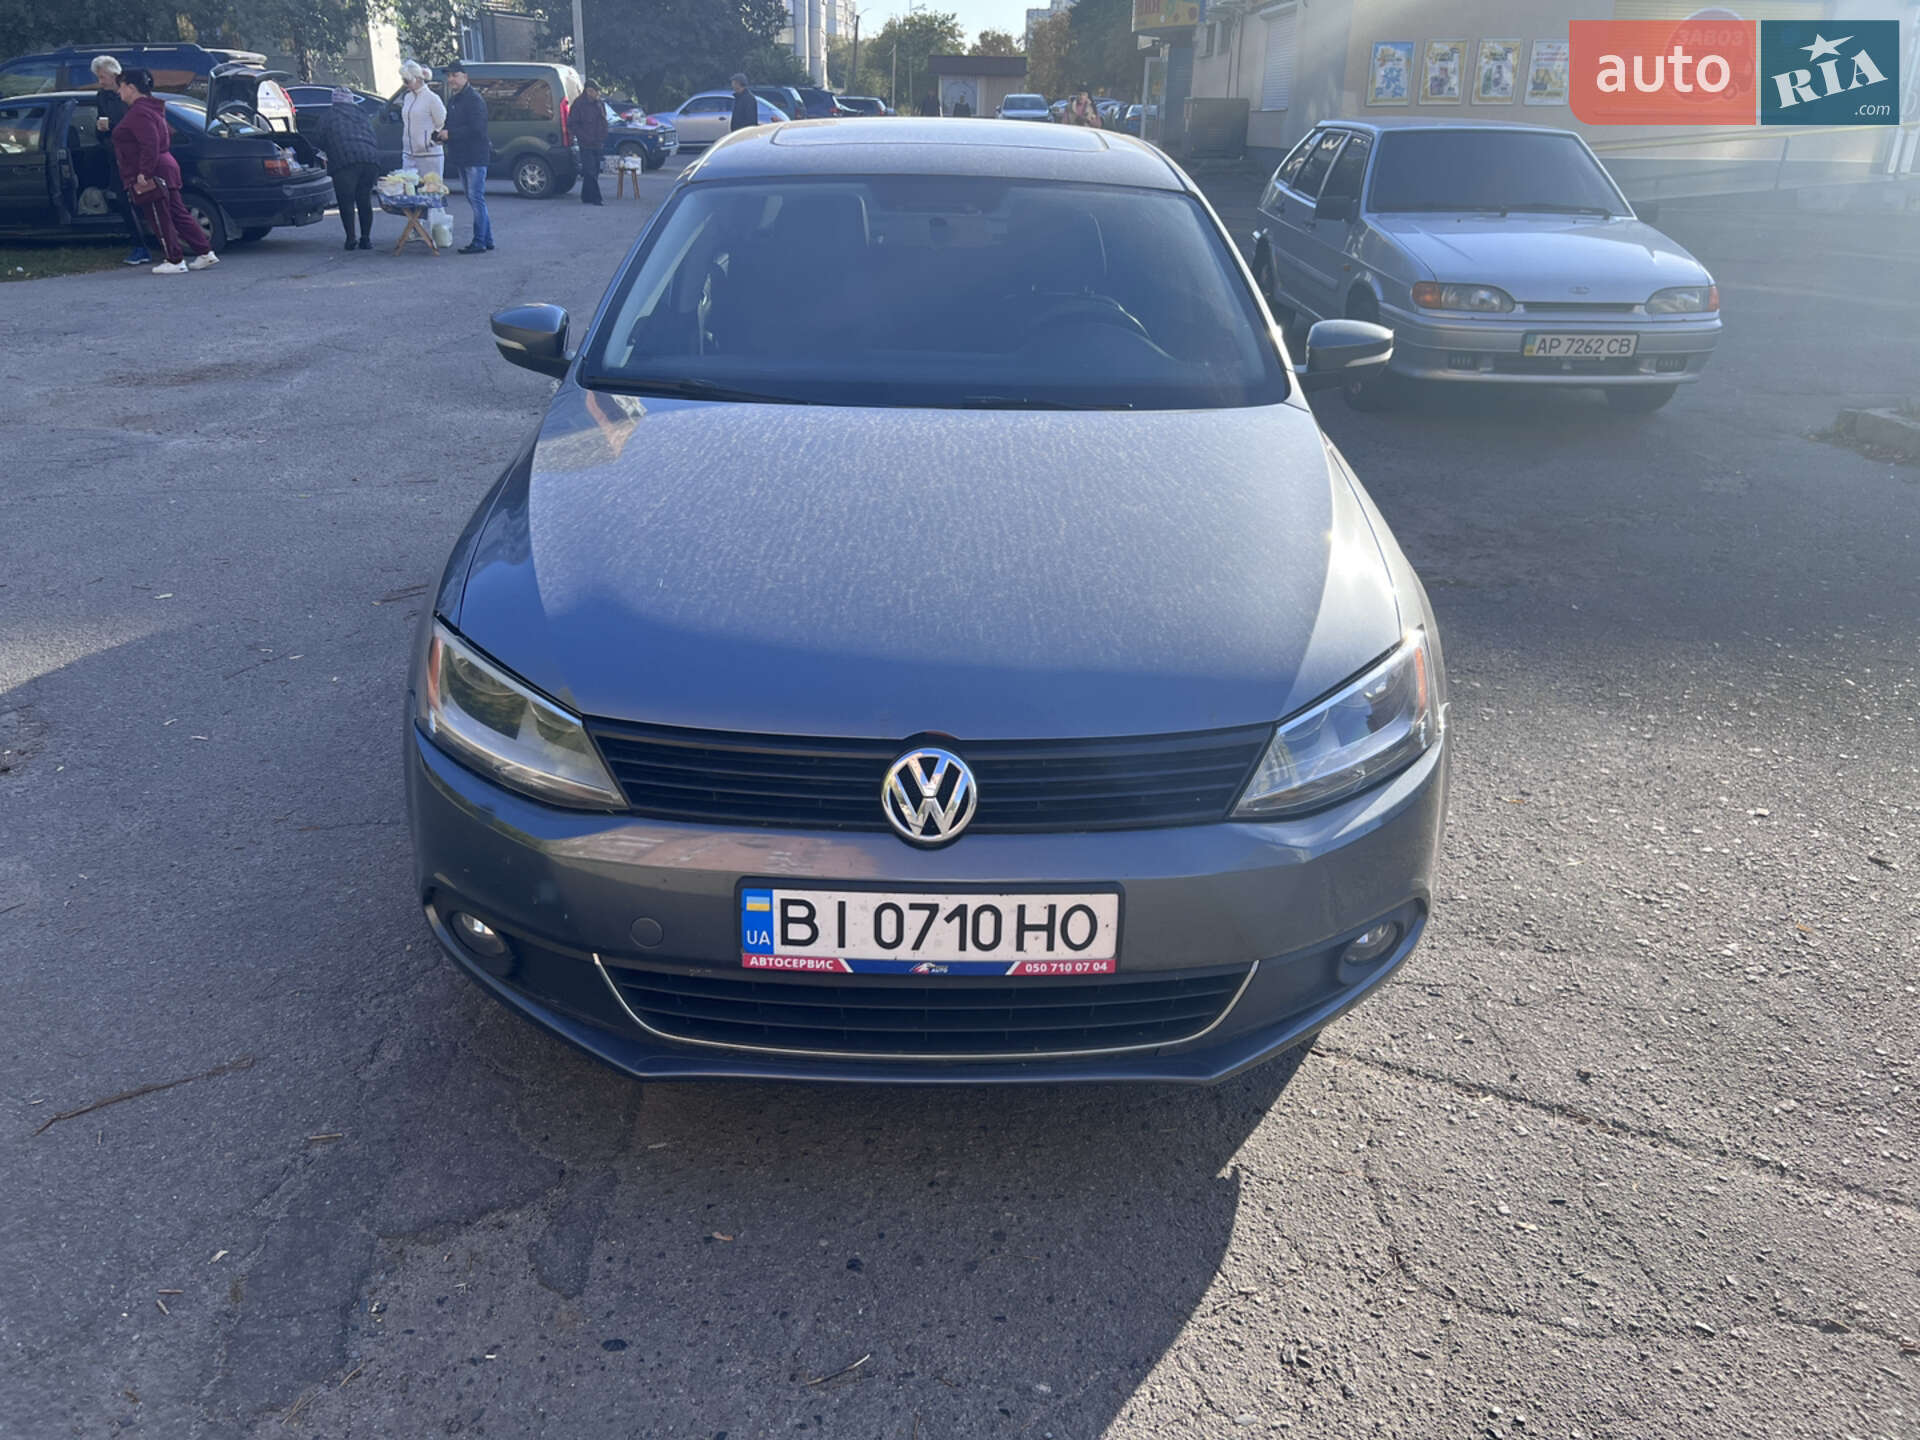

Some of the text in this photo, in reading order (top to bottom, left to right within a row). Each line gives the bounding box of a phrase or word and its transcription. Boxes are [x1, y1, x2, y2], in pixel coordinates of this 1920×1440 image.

[1536, 338, 1632, 354] AP 7262 CB
[873, 902, 1003, 952] 0710
[1016, 903, 1098, 952] HO
[746, 930, 771, 945] UA
[750, 956, 834, 969] АВТОСЕРВИС
[1025, 961, 1107, 973] 050 710 07 04
